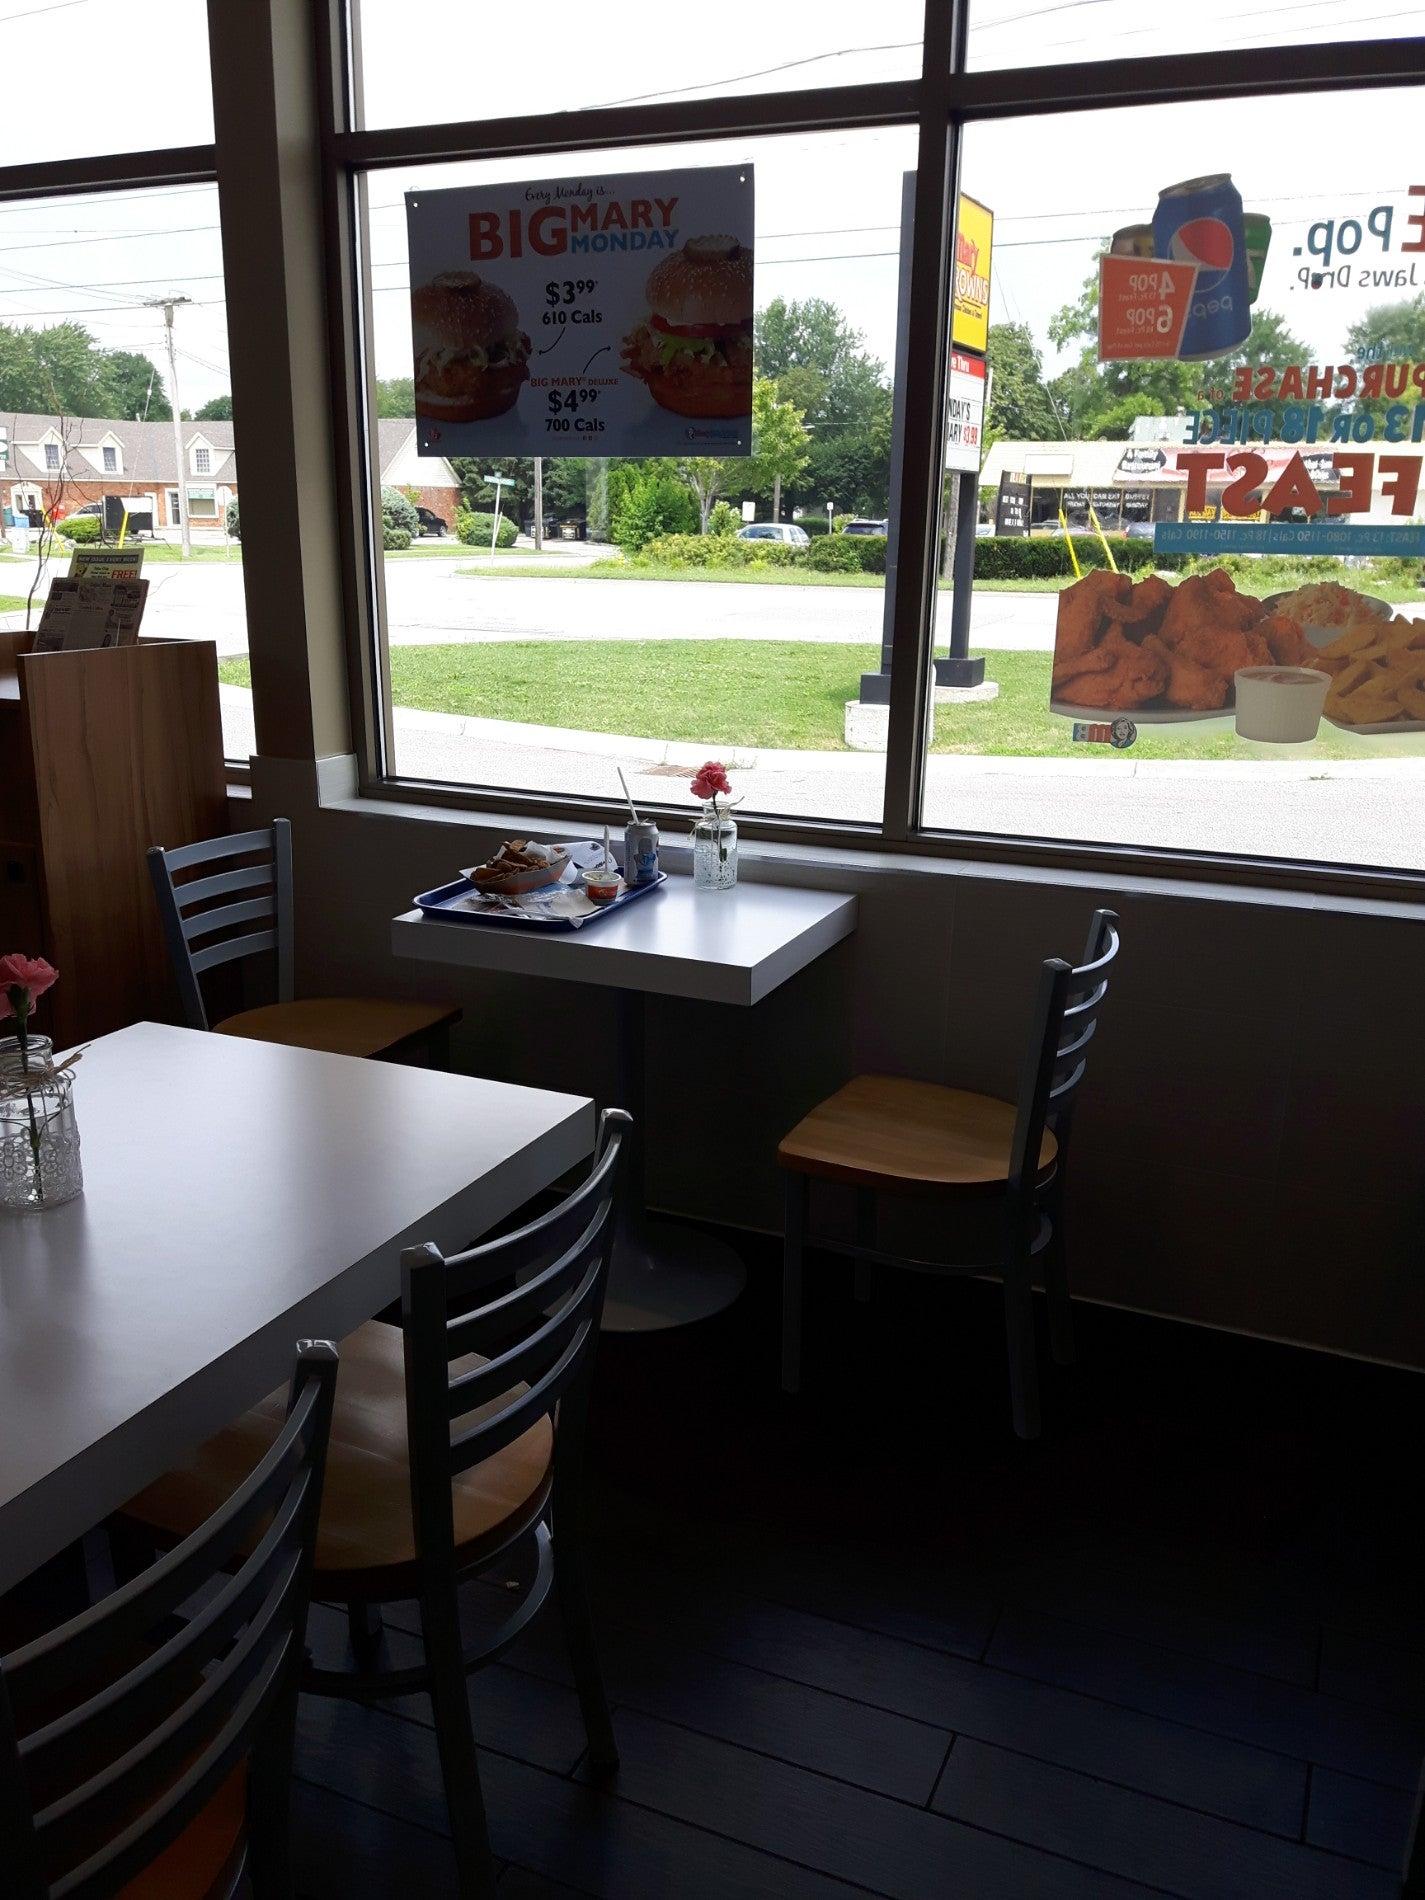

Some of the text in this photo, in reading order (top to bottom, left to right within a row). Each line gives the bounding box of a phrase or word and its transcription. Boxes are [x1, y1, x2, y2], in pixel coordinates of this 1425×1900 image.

[525, 186, 551, 205] Every
[554, 182, 593, 203] Monday
[468, 197, 680, 262] BIG MARY
[571, 229, 680, 254] MONDAY
[542, 309, 603, 326] 610 Cals
[530, 377, 549, 388] BIG
[545, 417, 606, 433] 700 Cals
